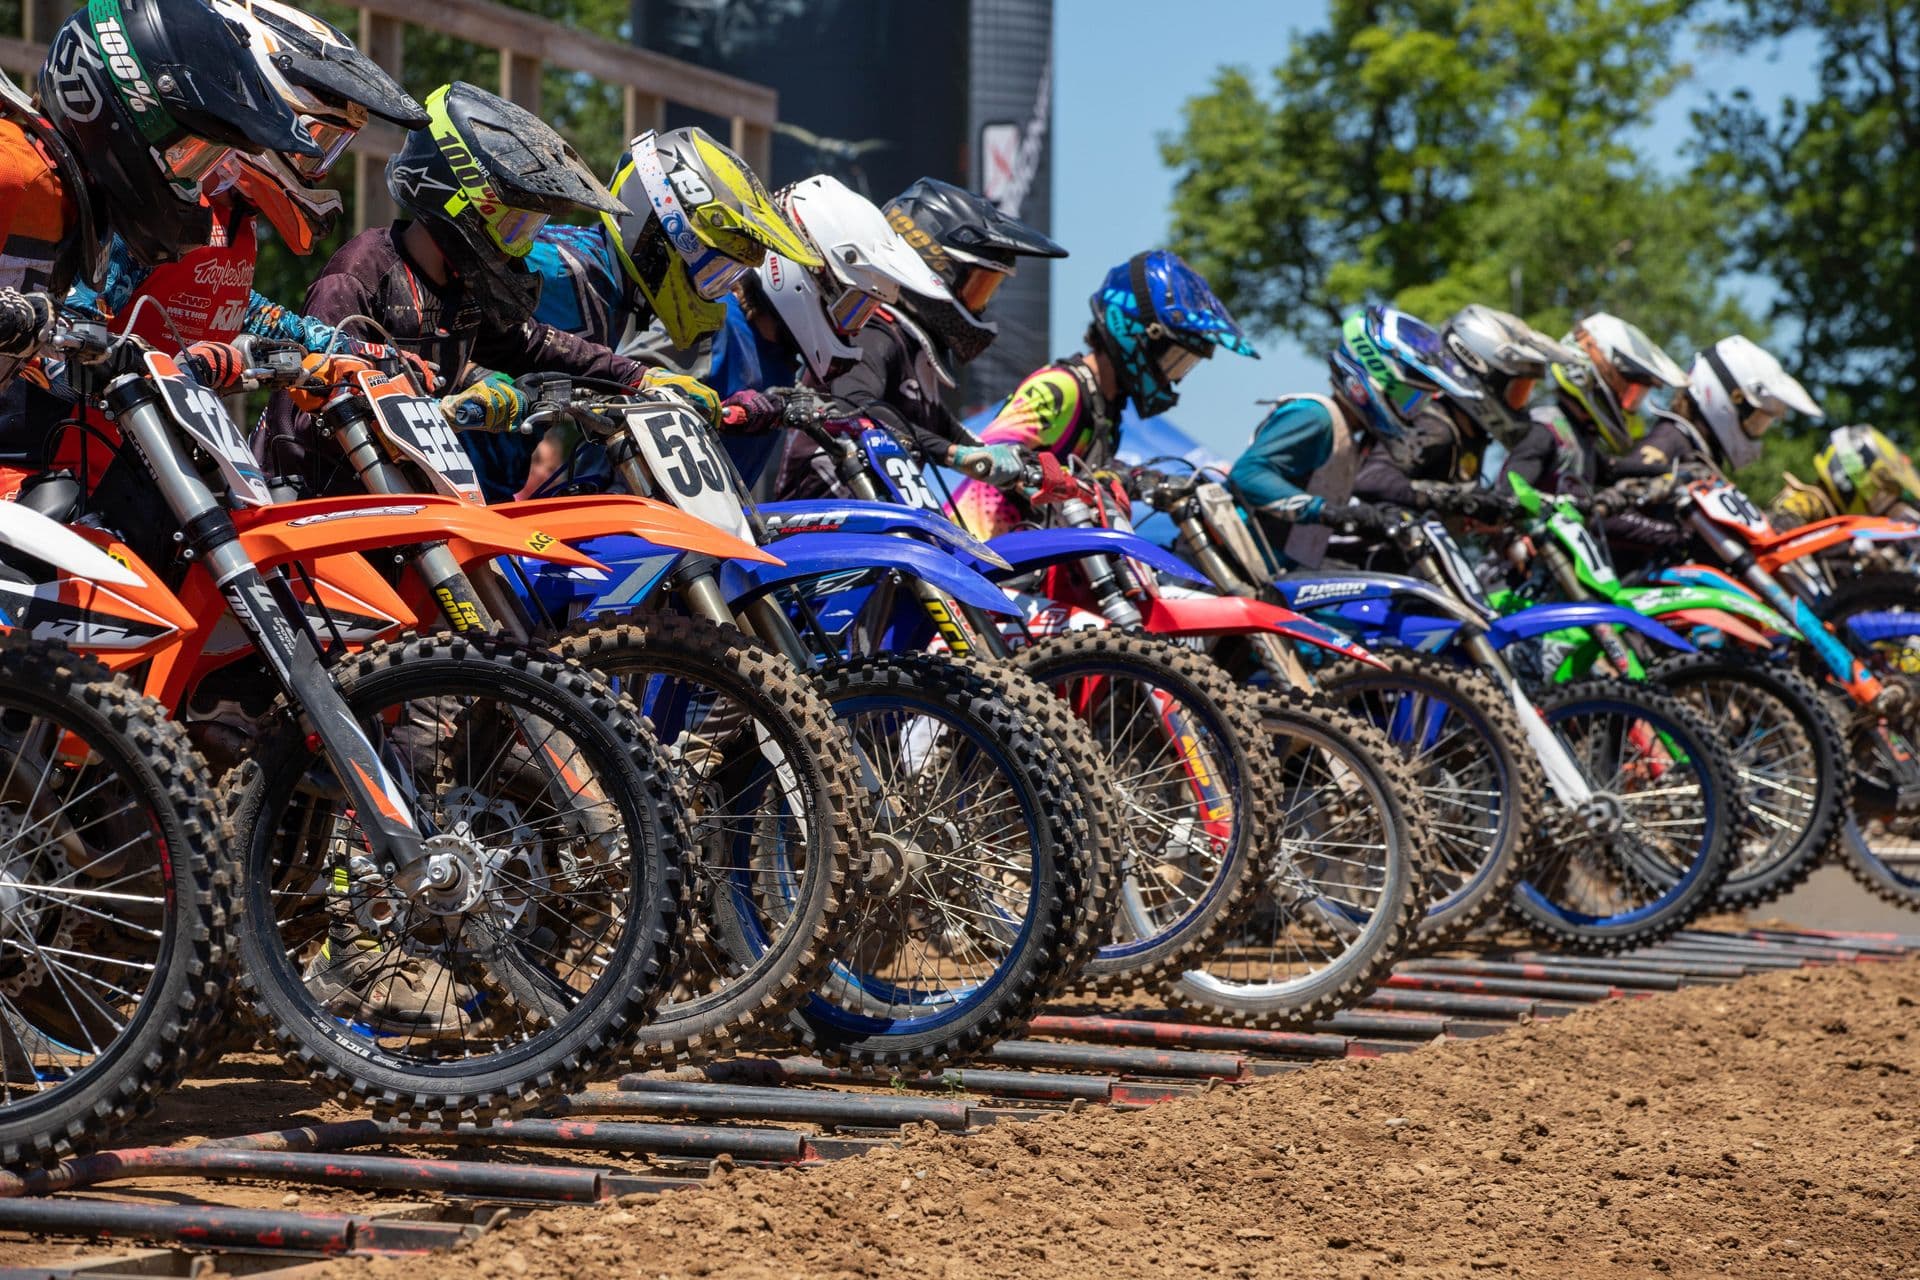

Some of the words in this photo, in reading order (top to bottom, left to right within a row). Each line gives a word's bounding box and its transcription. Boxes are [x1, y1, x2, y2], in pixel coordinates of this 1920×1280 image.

[95, 17, 159, 112] 100%
[436, 131, 503, 216] 100%
[885, 208, 952, 272] 100%
[770, 256, 781, 285] BELL
[209, 300, 247, 331] KTM
[1352, 334, 1395, 391] 100%
[1297, 582, 1368, 599] FUSION
[531, 696, 566, 722] EXCEL
[335, 1033, 371, 1058] EXCEL
